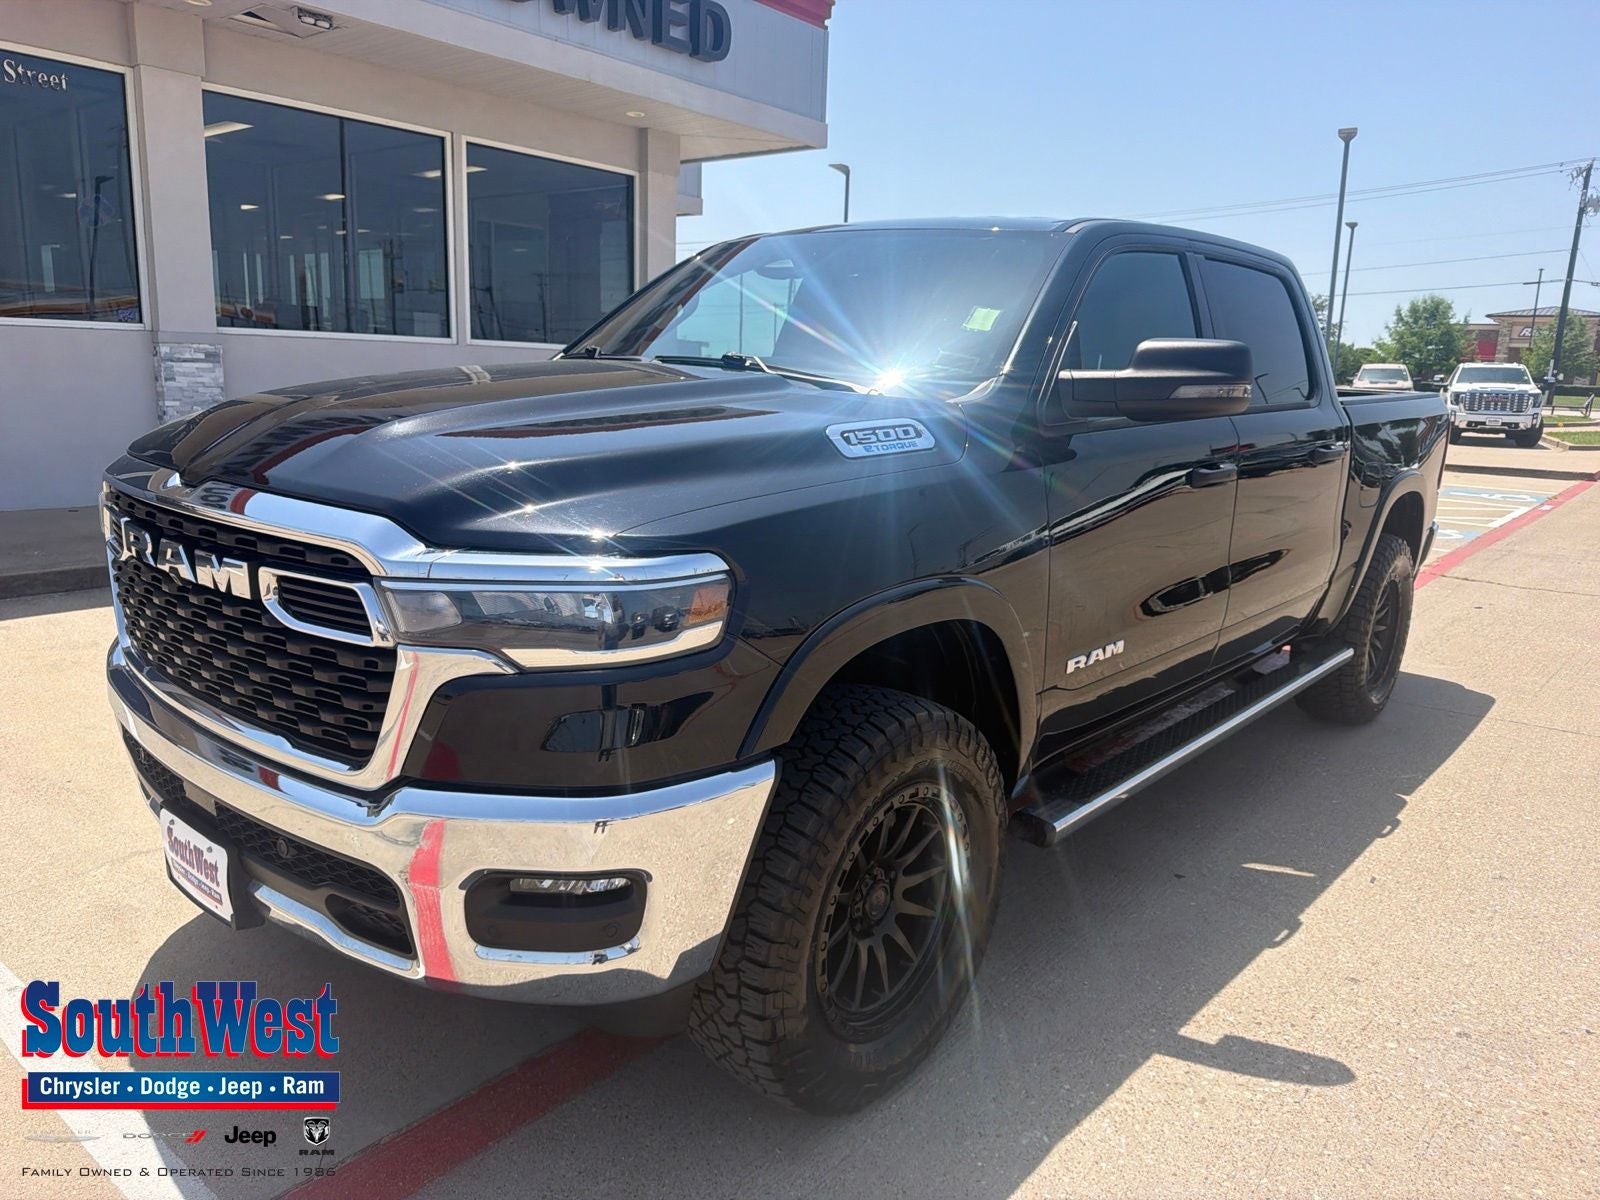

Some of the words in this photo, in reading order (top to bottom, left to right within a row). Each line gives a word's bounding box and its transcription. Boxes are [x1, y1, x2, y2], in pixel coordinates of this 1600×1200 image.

[3, 59, 69, 91] Street
[843, 426, 917, 445] 1500
[103, 503, 251, 600] RAM
[1065, 639, 1125, 675] RAM
[166, 825, 220, 887] SouthWest
